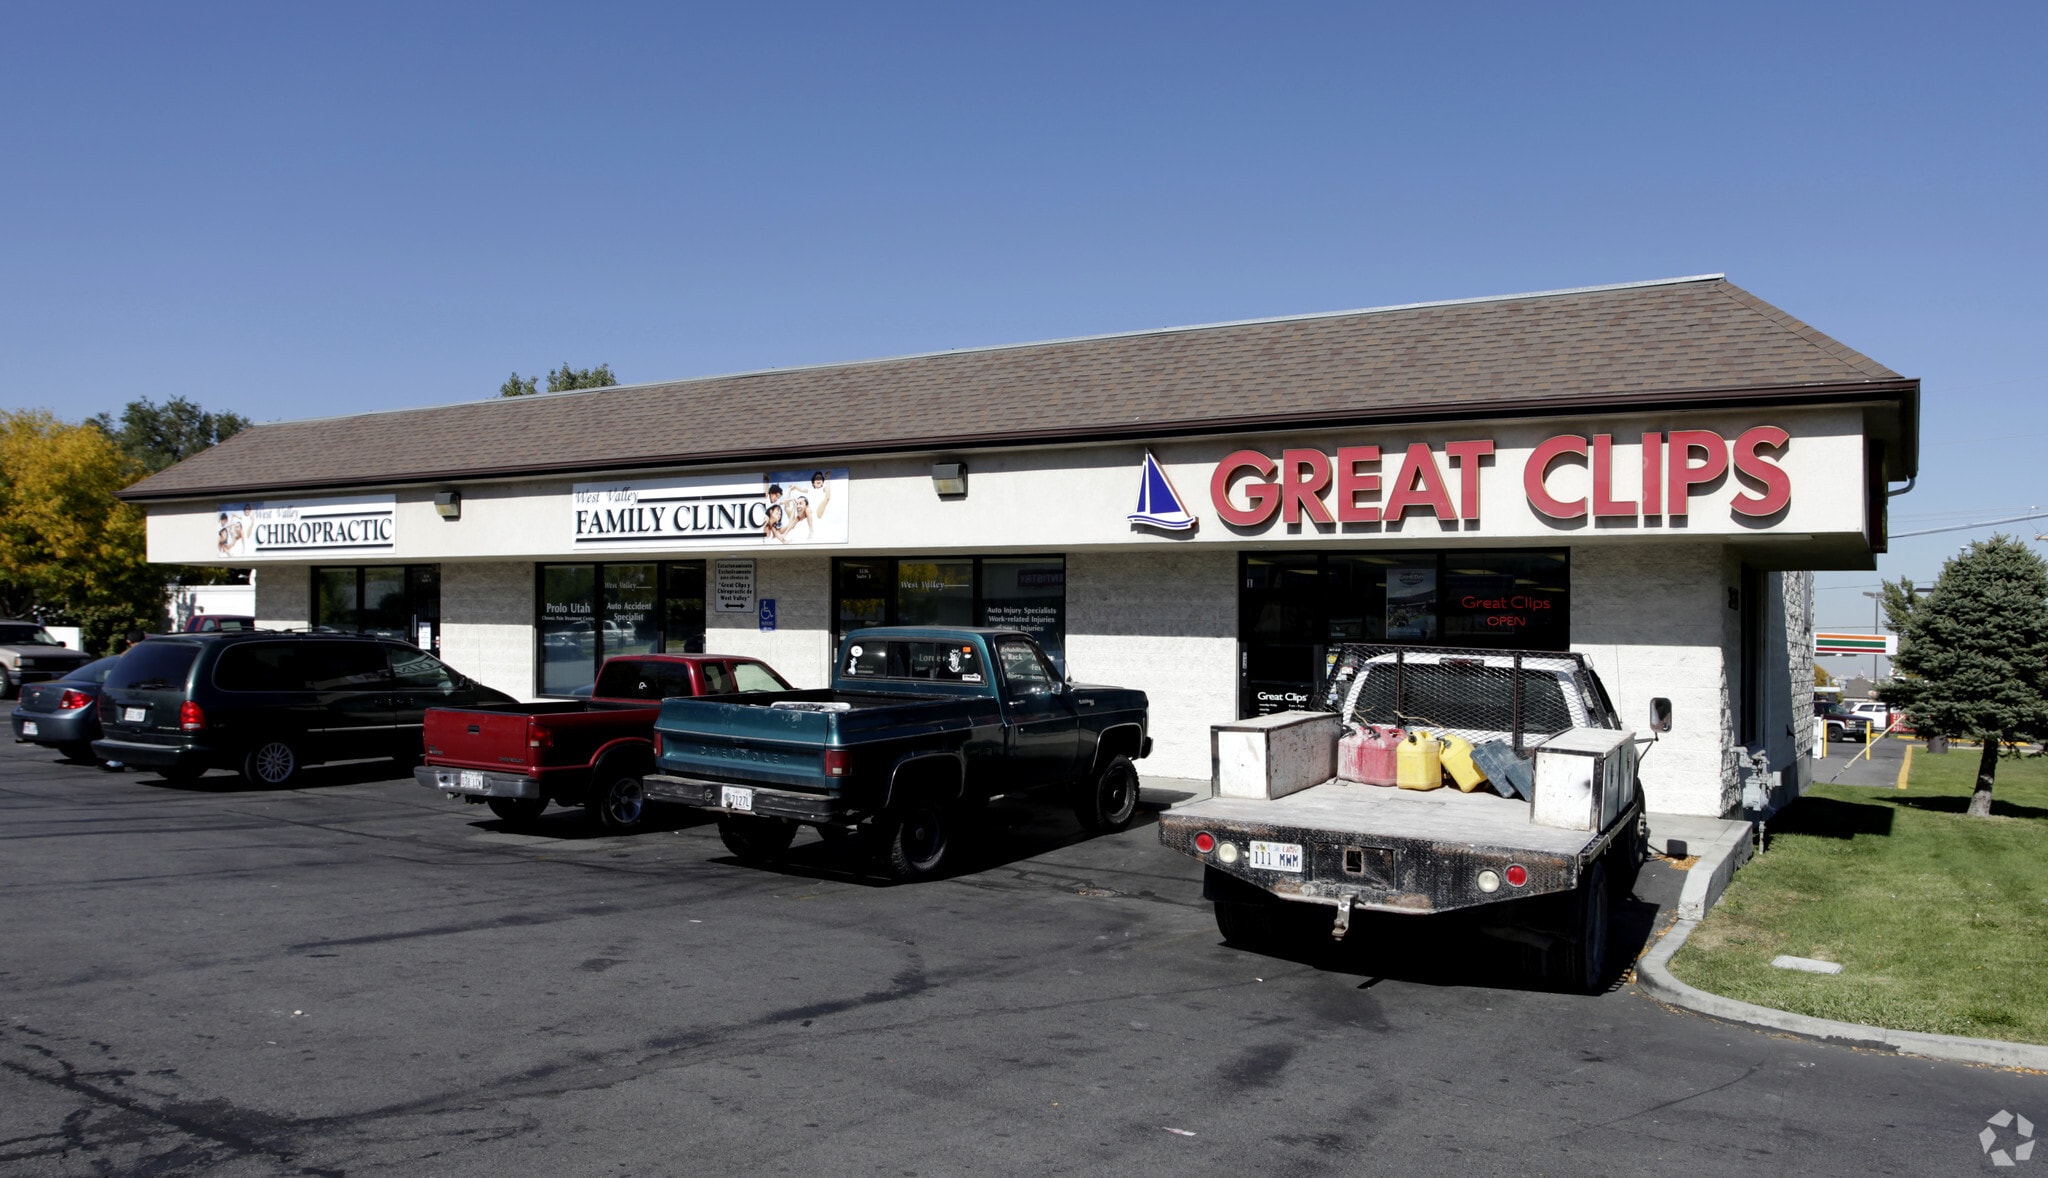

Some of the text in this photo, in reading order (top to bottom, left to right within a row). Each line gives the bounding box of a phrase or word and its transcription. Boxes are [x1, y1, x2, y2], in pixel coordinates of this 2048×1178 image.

[1210, 425, 1791, 526] GREAT CLIPS
[576, 487, 638, 505] West Valley
[255, 505, 299, 521] West Valley
[576, 502, 767, 534] FAMILY CLINIC
[255, 518, 392, 545] CHIROPRACTIC
[619, 581, 637, 591] Valley
[901, 580, 945, 591] West Valley
[546, 602, 591, 613] Prolo Utah
[606, 602, 652, 610] Auto Accident
[1461, 595, 1551, 611] Great Clips
[1003, 606, 1022, 616] Injury
[1023, 607, 1056, 615] Specialists
[614, 613, 644, 622] Specialist
[1031, 616, 1055, 624] Injuries
[1487, 616, 1526, 626] OPEN
[1020, 624, 1044, 633] Injuries
[1007, 653, 1023, 661] Back
[1257, 691, 1308, 703] Great Clips
[700, 745, 788, 765] CHEVROLET
[1255, 851, 1299, 867] 111 MWM
